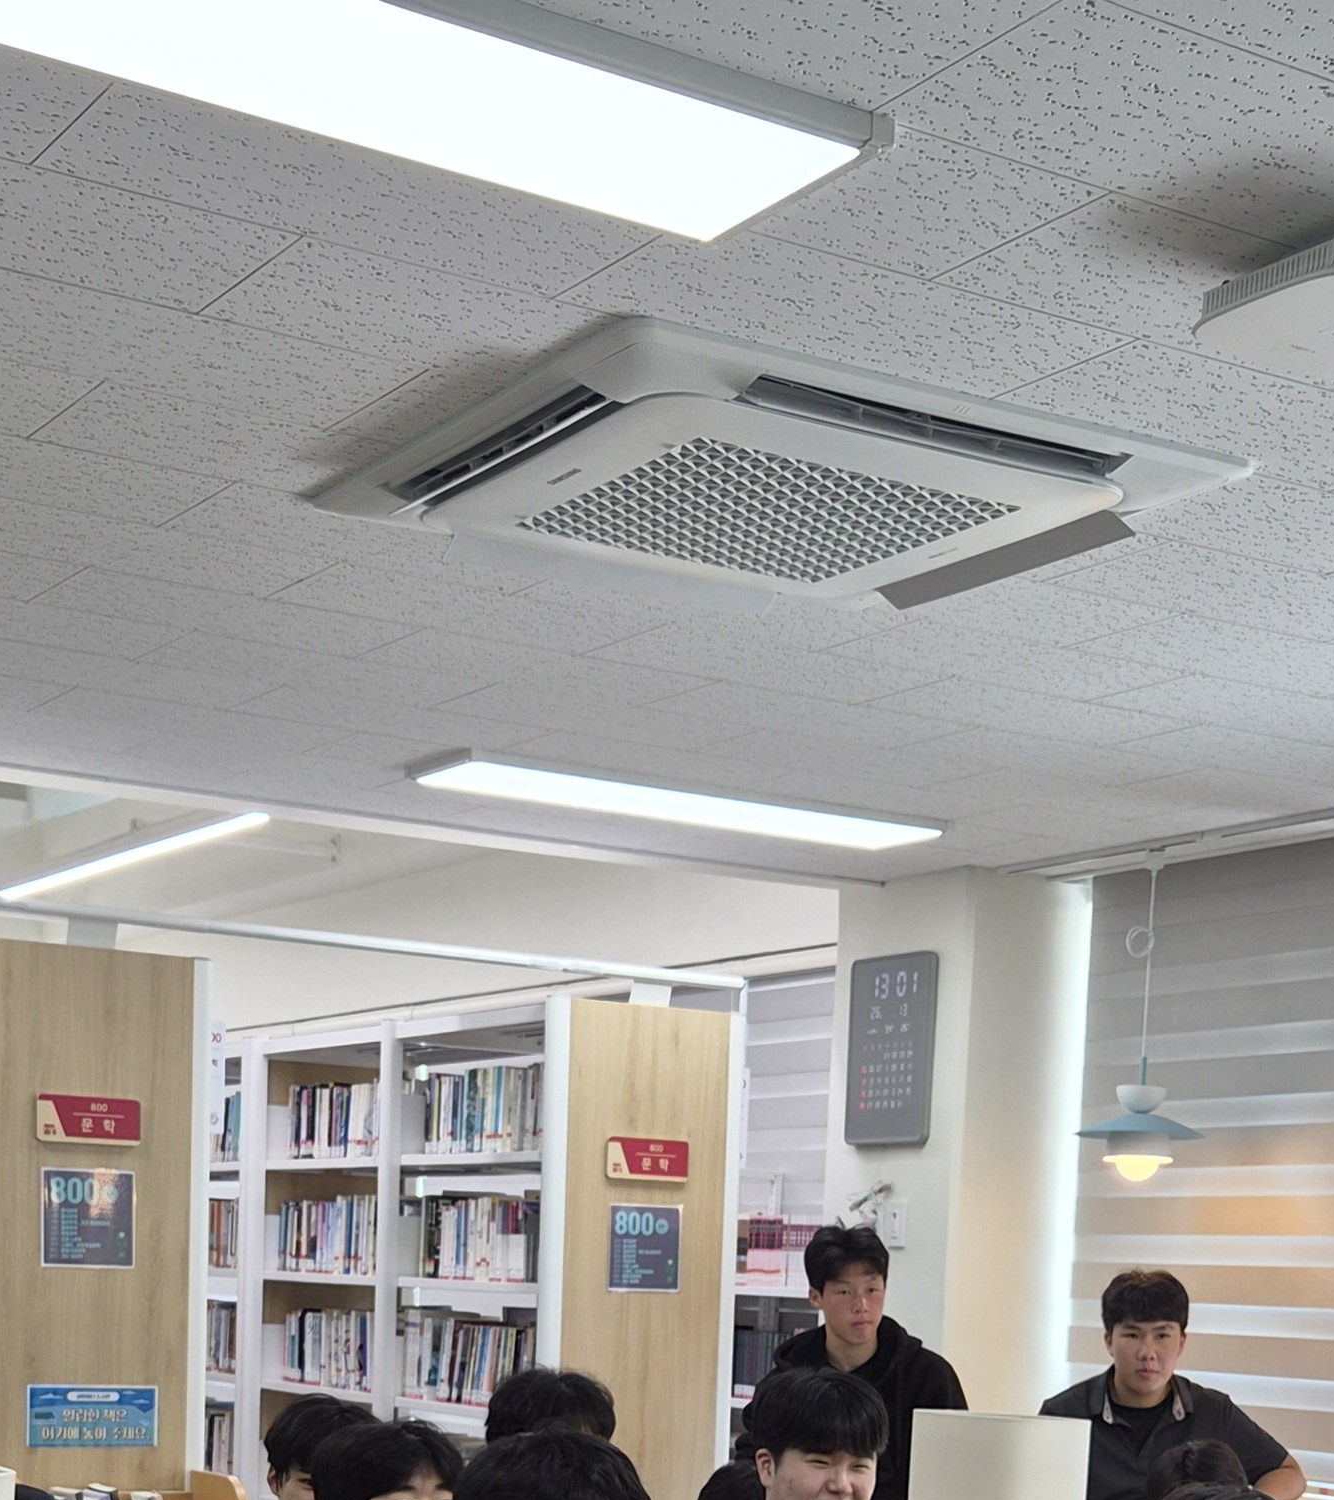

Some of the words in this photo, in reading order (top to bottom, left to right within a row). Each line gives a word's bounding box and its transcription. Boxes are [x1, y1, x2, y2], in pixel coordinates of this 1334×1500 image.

[90, 1103, 108, 1113] 800
[50, 1176, 100, 1205] 800
[615, 1211, 654, 1236] 800
